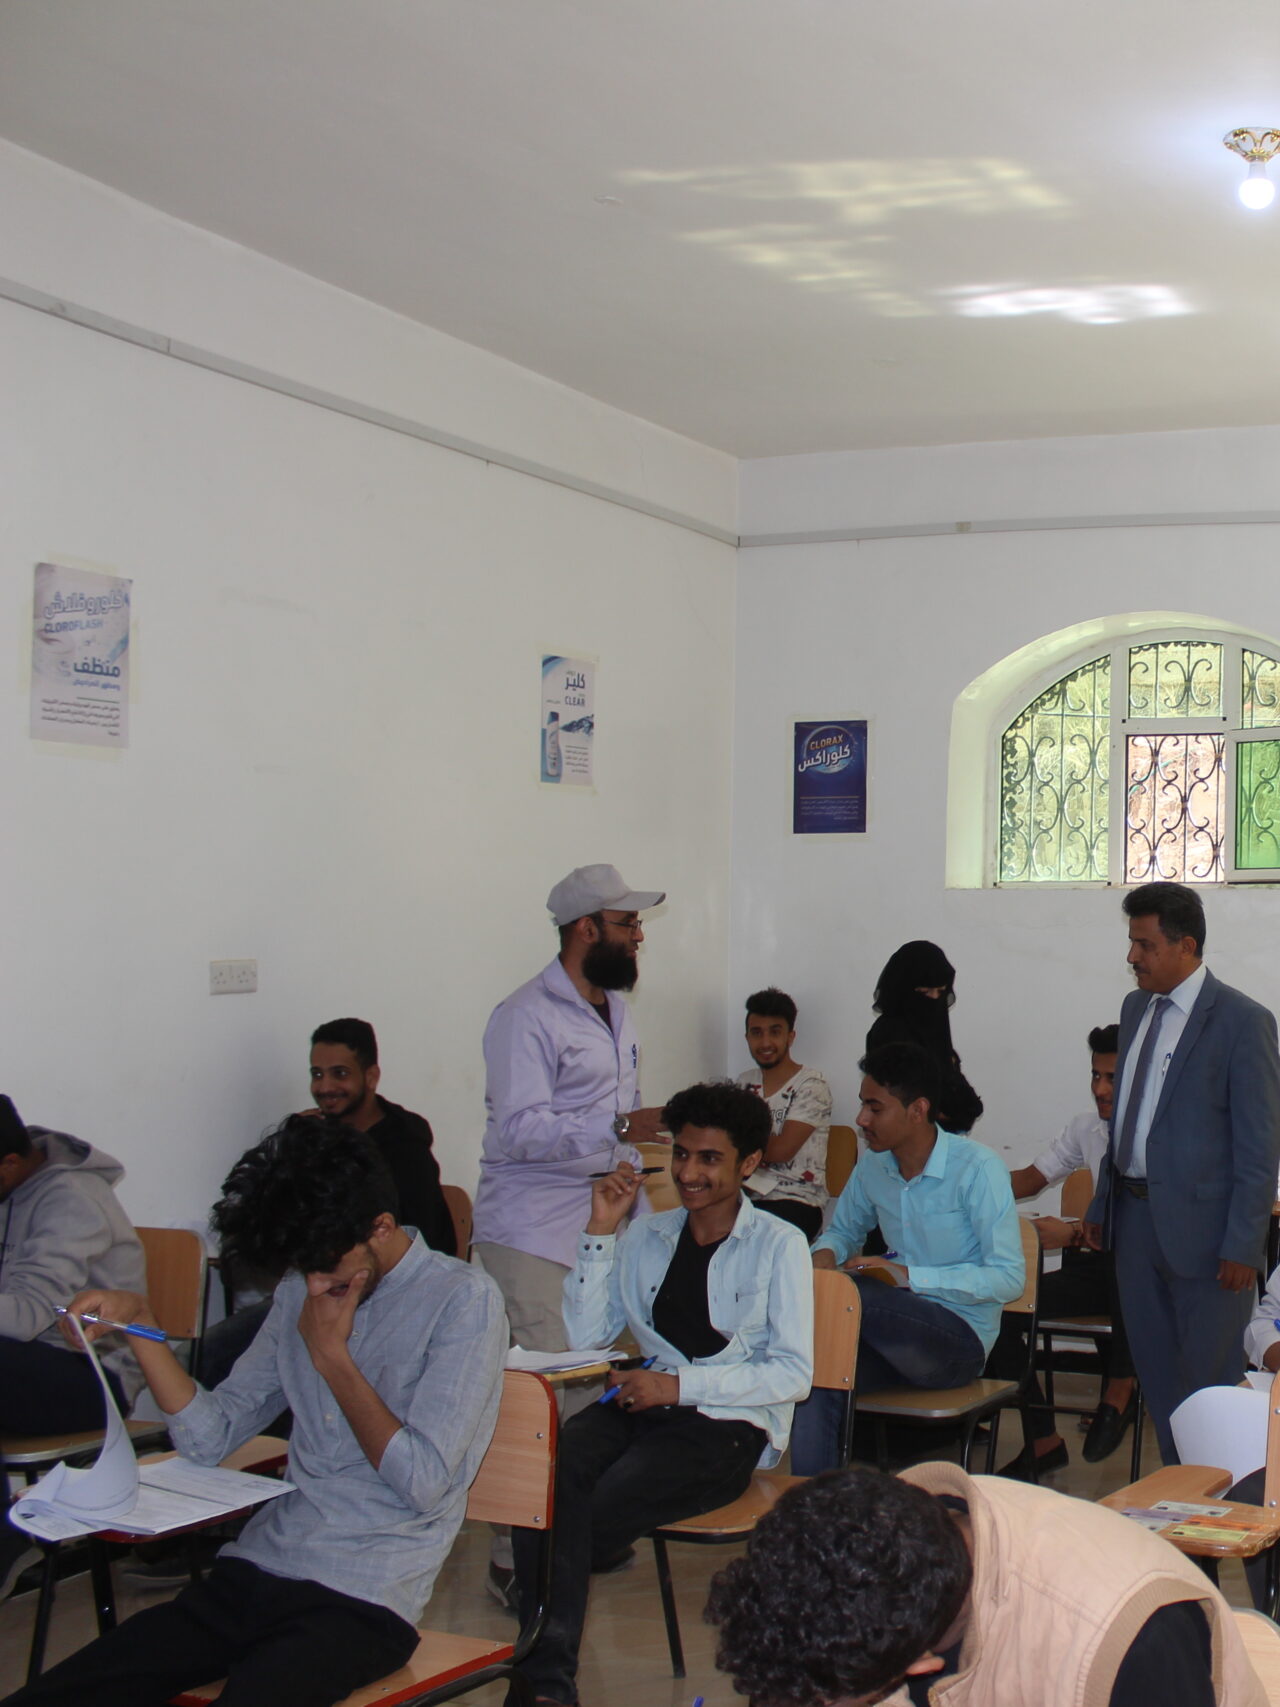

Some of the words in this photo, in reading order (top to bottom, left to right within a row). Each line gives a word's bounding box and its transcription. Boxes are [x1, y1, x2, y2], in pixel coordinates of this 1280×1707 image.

[44, 619, 104, 634] CLOROFLASH
[73, 656, 121, 678] منظف
[565, 695, 585, 707] CLEAR
[810, 734, 844, 751] CLORAX
[798, 744, 851, 772] كلوراكس
